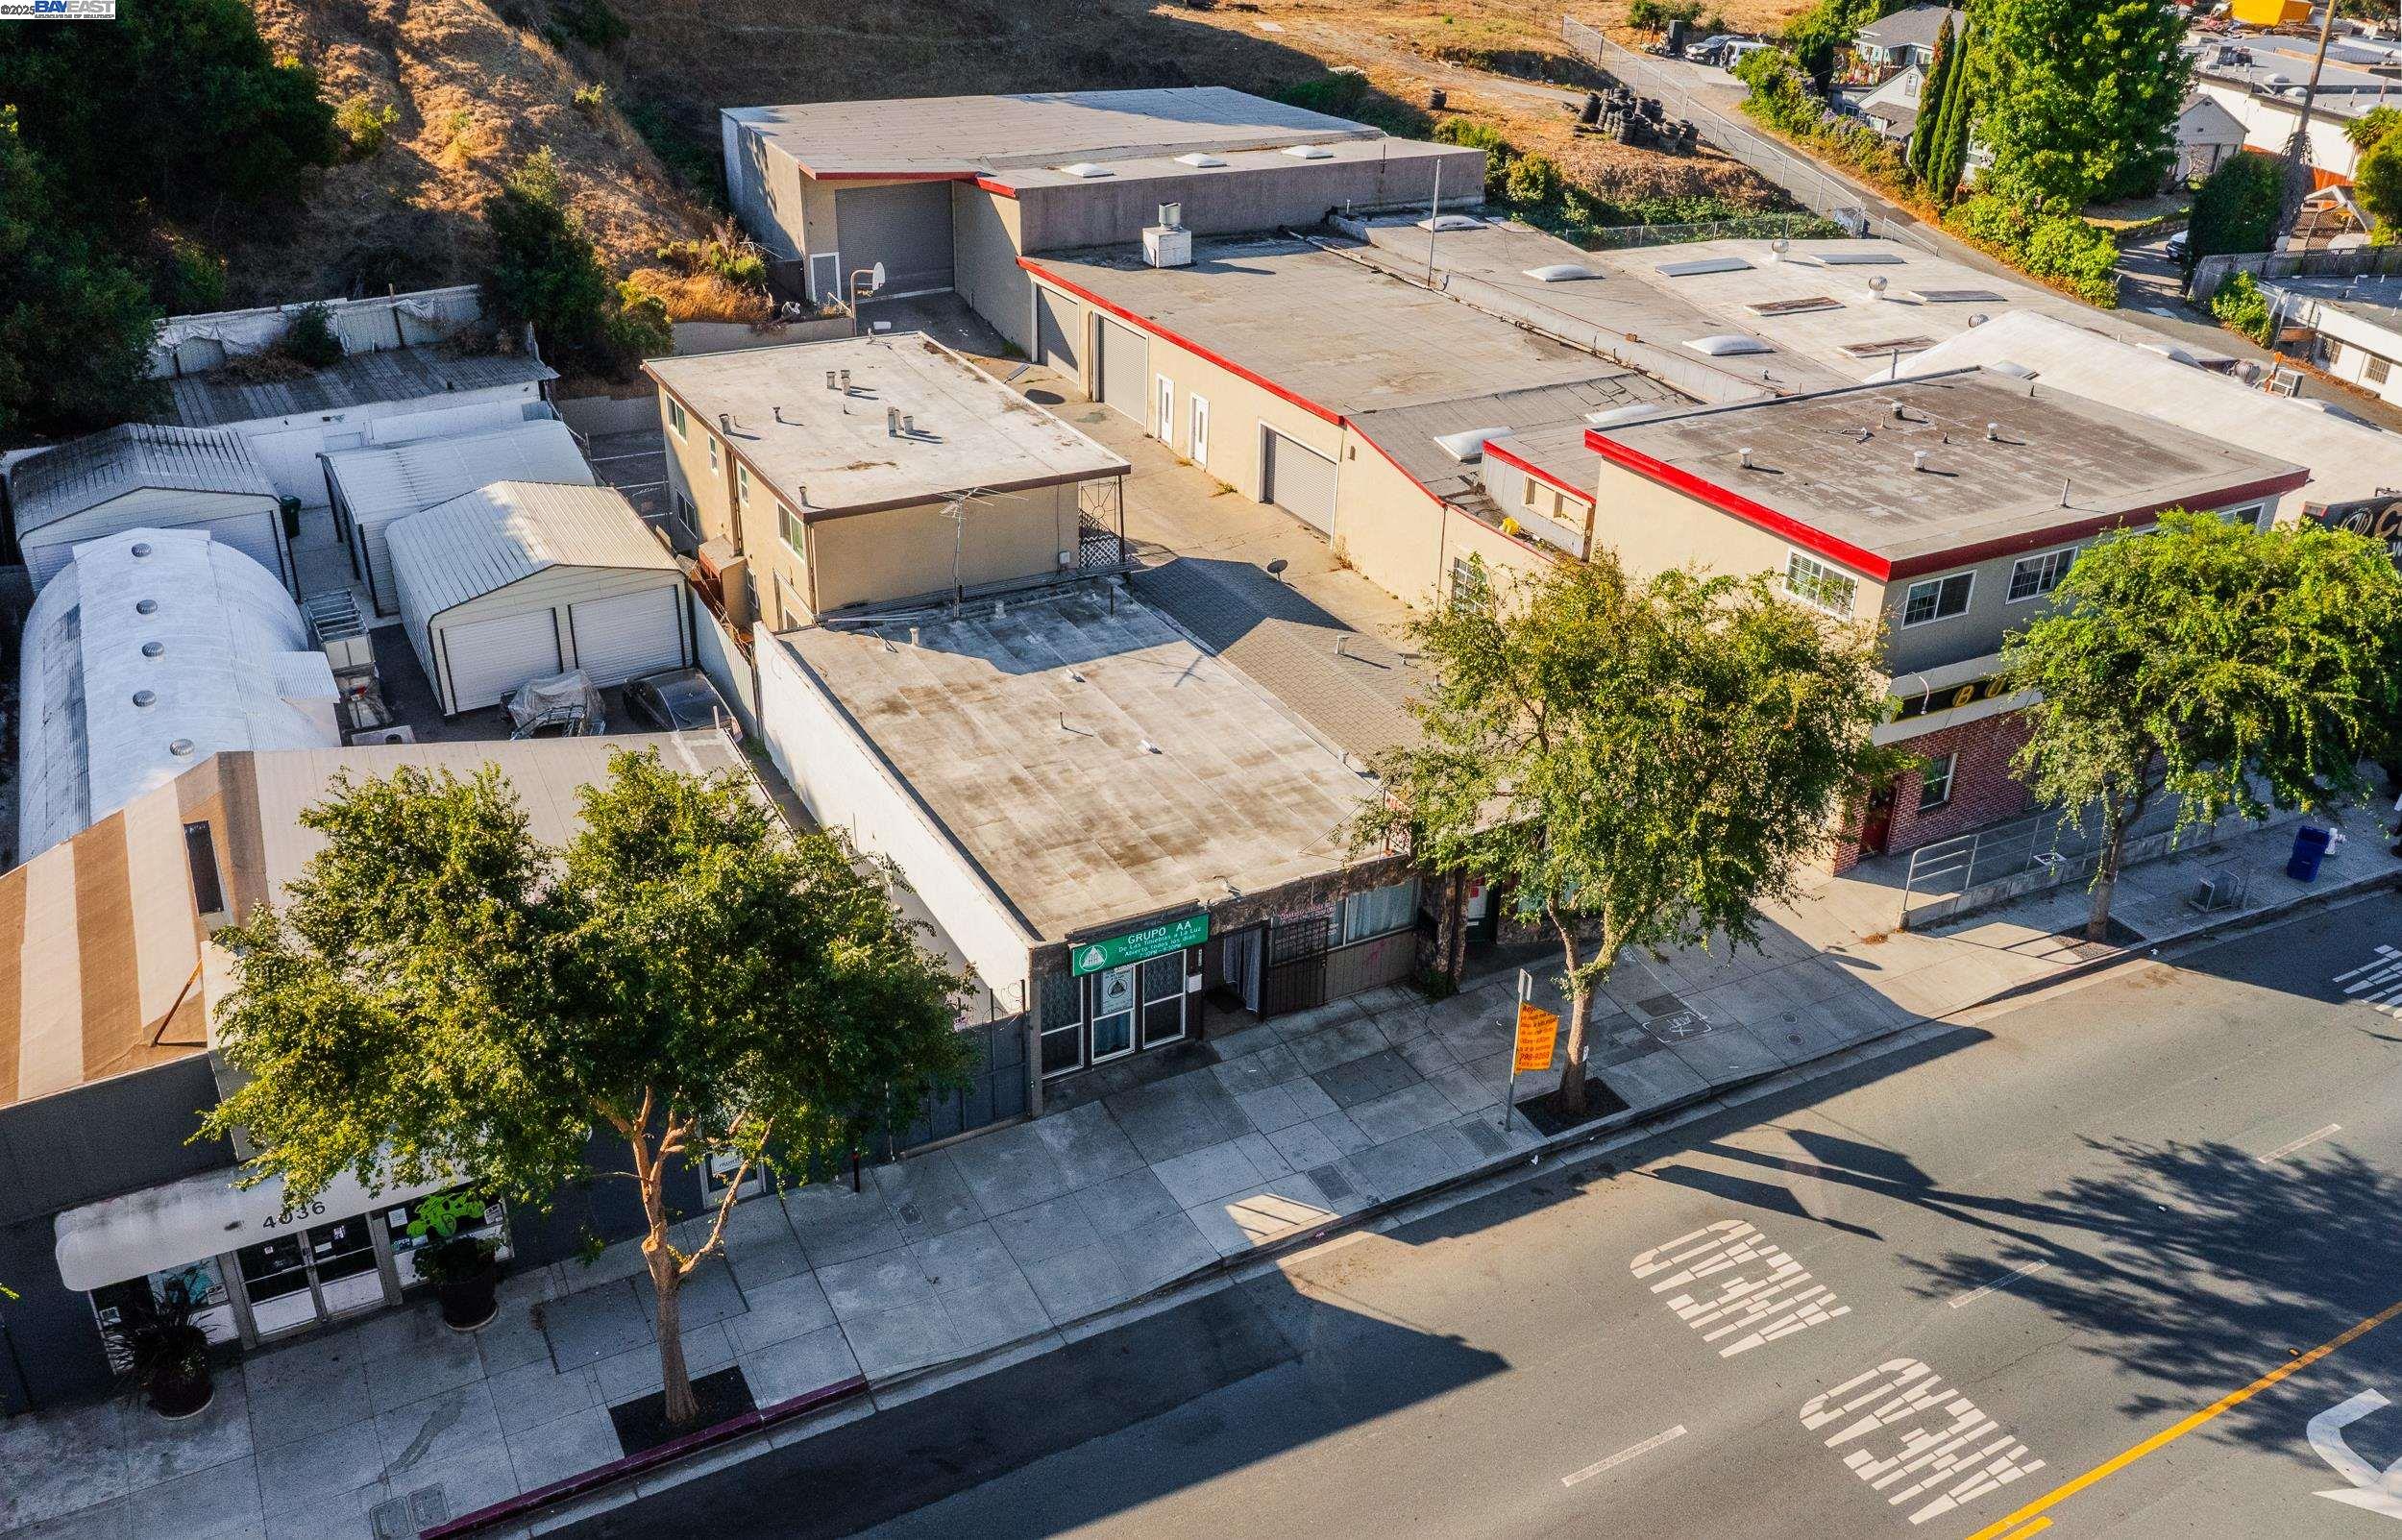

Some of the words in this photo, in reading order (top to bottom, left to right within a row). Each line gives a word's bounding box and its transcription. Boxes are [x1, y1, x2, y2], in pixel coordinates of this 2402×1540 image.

[1128, 927, 1166, 944] GRUPO
[1176, 921, 1191, 932] AA
[262, 1201, 326, 1228] 4036
[1630, 1219, 1852, 1358] AHEAD
[1799, 1357, 2047, 1526] AHEAD
